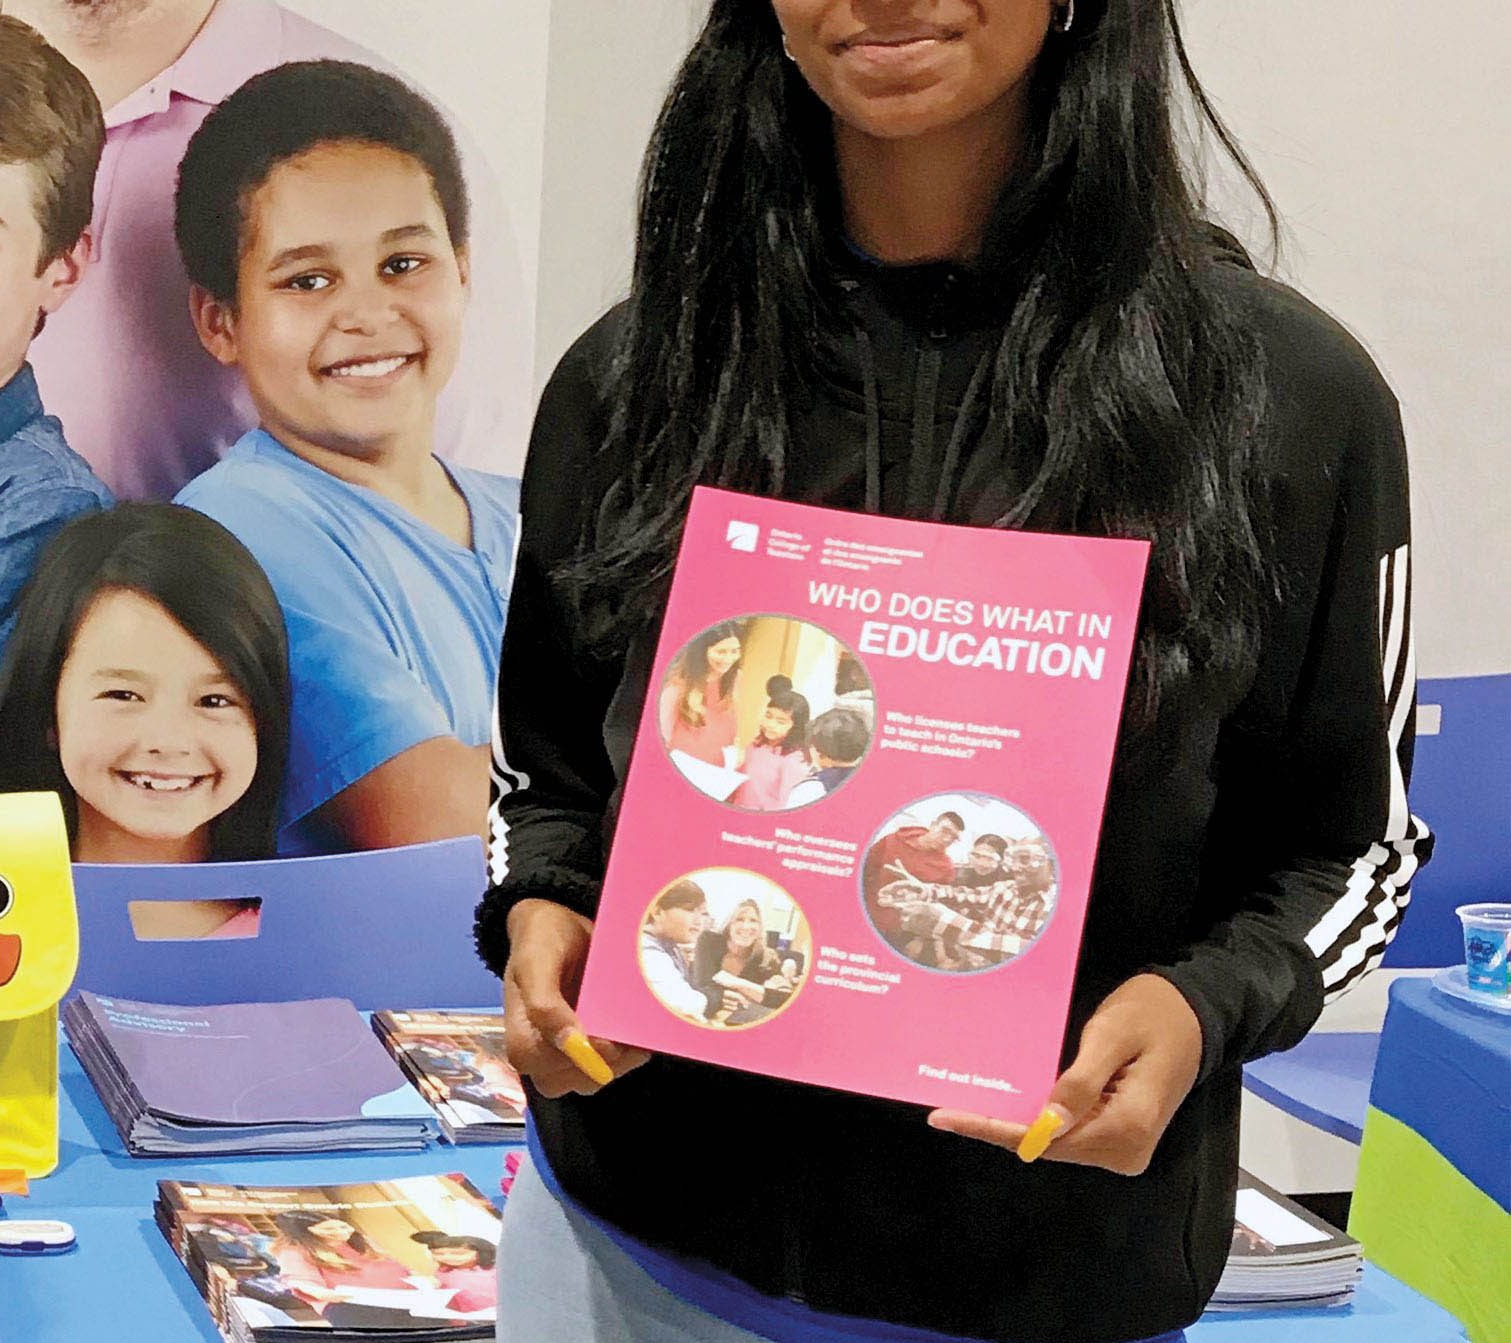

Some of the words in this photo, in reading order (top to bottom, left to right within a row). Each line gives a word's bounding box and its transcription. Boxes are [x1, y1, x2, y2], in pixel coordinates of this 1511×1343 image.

[808, 580, 881, 613] WHO
[888, 592, 974, 626] DOES
[982, 603, 1074, 635] WHAT
[1078, 613, 1112, 640] IN
[858, 620, 1106, 680] EDUCATION
[883, 724, 897, 735] to
[898, 726, 933, 739] teach
[886, 711, 912, 724] Who
[914, 714, 964, 731] licenses
[966, 722, 1020, 739] teachers
[880, 738, 919, 752] public
[920, 743, 976, 759] schools?
[775, 827, 802, 842] Who
[820, 945, 847, 960] Who
[816, 959, 838, 972] the
[918, 1064, 947, 1080] Find
[948, 1071, 970, 1084] out
